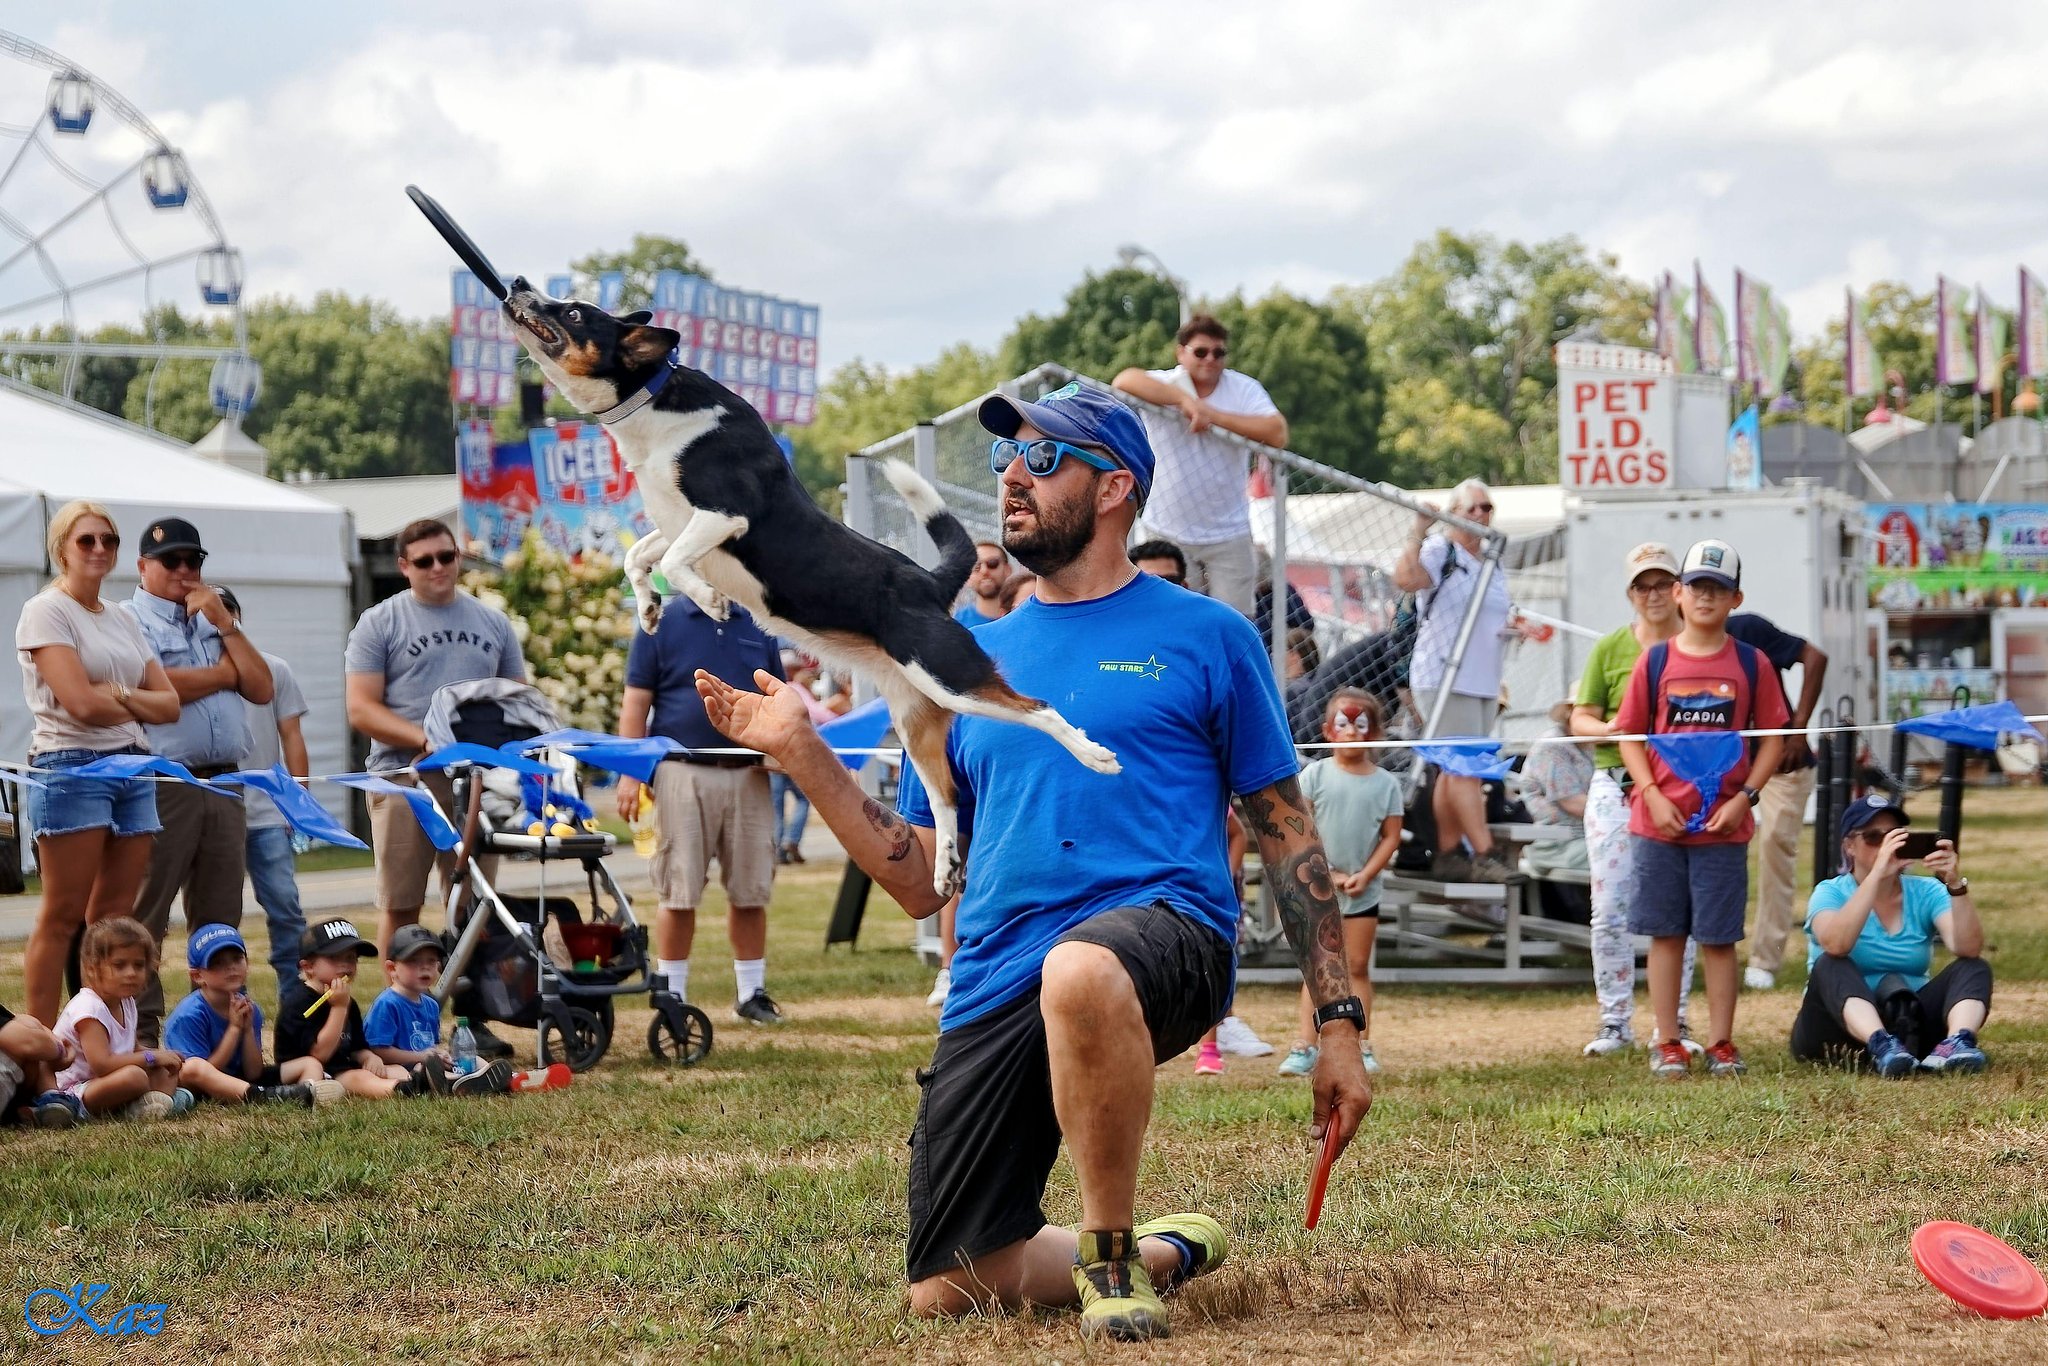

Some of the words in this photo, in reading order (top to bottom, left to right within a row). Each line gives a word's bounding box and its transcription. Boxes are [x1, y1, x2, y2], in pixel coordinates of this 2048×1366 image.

[1574, 381, 1656, 413] PET
[1577, 417, 1652, 449] I.D.
[543, 436, 614, 484] ICEE
[1567, 452, 1667, 485] TAGS
[407, 629, 492, 656] UPSTATE
[1099, 663, 1118, 671] PAW
[1119, 664, 1144, 673] STARS
[1673, 710, 1727, 724] ACADIA
